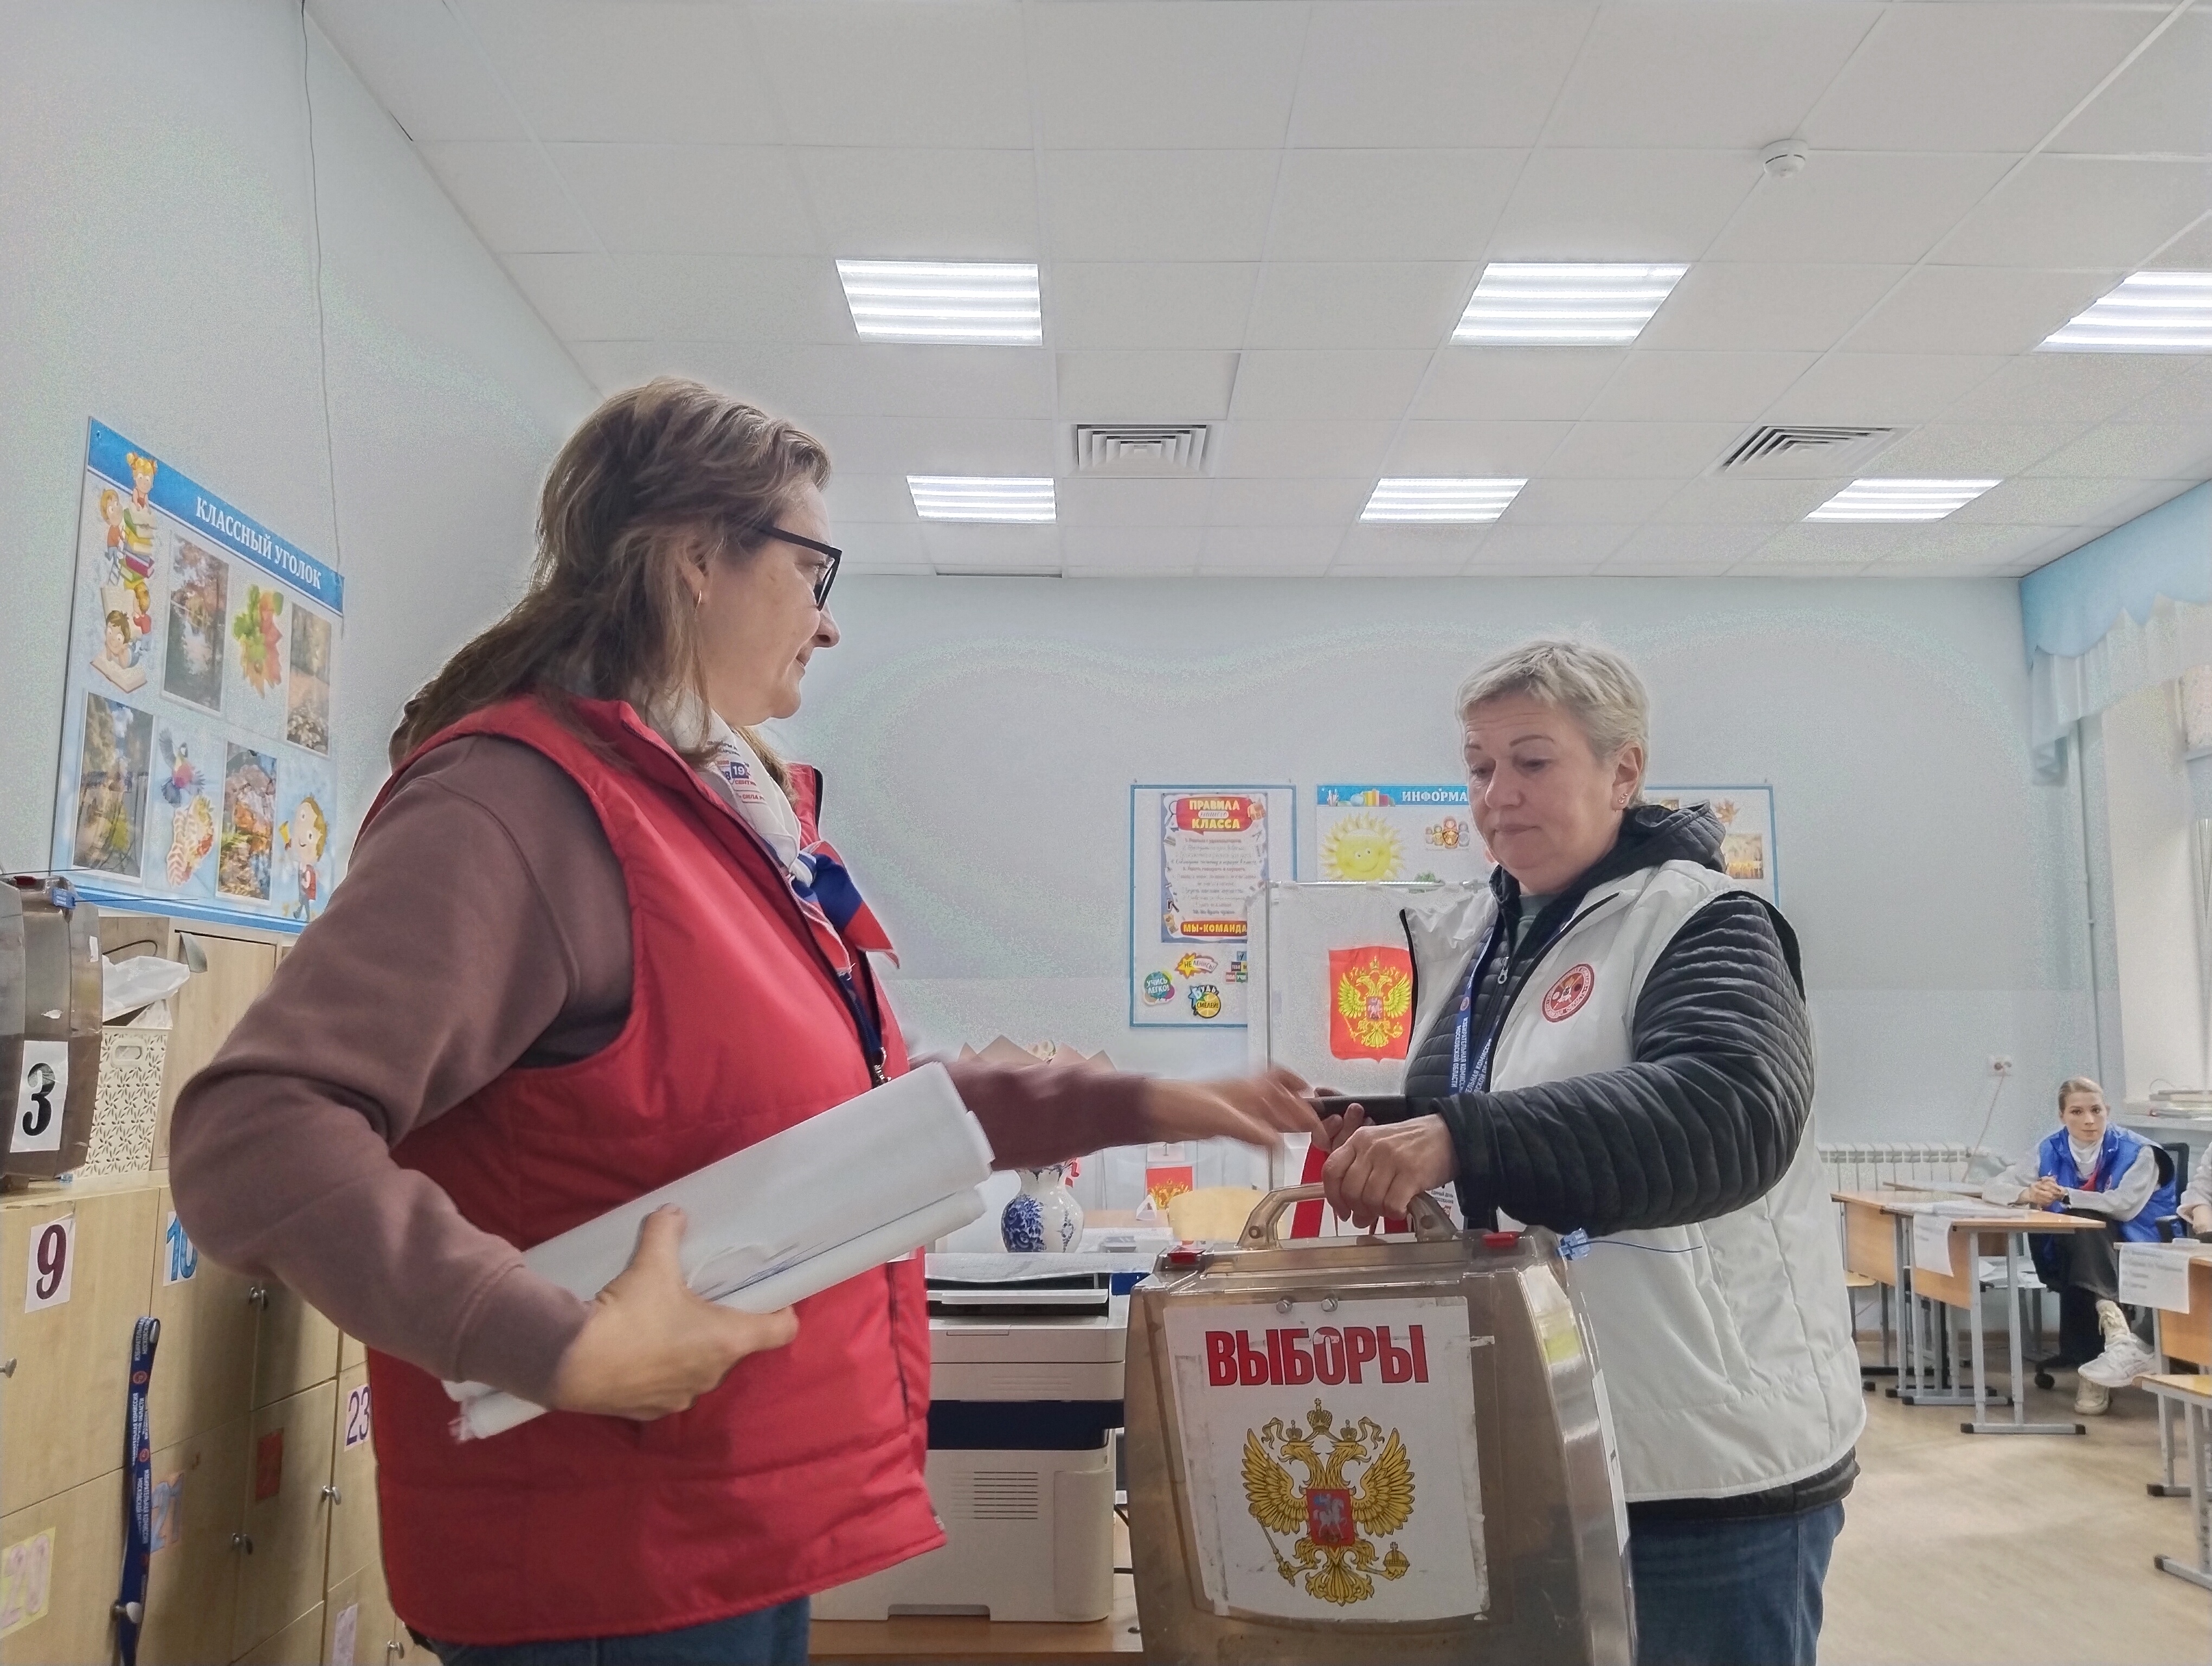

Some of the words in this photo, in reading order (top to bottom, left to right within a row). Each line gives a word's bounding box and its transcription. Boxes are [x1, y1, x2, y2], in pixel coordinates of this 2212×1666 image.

[196, 496, 273, 560] КЛАССНЫЙ
[274, 544, 321, 589] УГОЛОК
[732, 766, 745, 776] 19
[1189, 799, 1240, 810] ПРАВИЛА
[1402, 791, 1468, 802] ИНФОРМА
[1192, 818, 1240, 829] КЛАССА
[1146, 978, 1168, 987] УЧИСЬ
[1147, 984, 1169, 994] ЛЕГКО!
[1453, 1024, 1462, 1062] МОСКОВСКОЙ
[1460, 1017, 1469, 1063] ИЗБИРАТЕЛЬНАЯ
[1451, 1062, 1459, 1087] ОБЛАСТИ
[1465, 1069, 1480, 1093] ЕЛЬНАЯ
[22, 1063, 55, 1136] 3
[36, 1224, 67, 1300] 9
[1205, 1324, 1429, 1386] ВЫБОРЫ
[345, 1386, 371, 1446] 23
